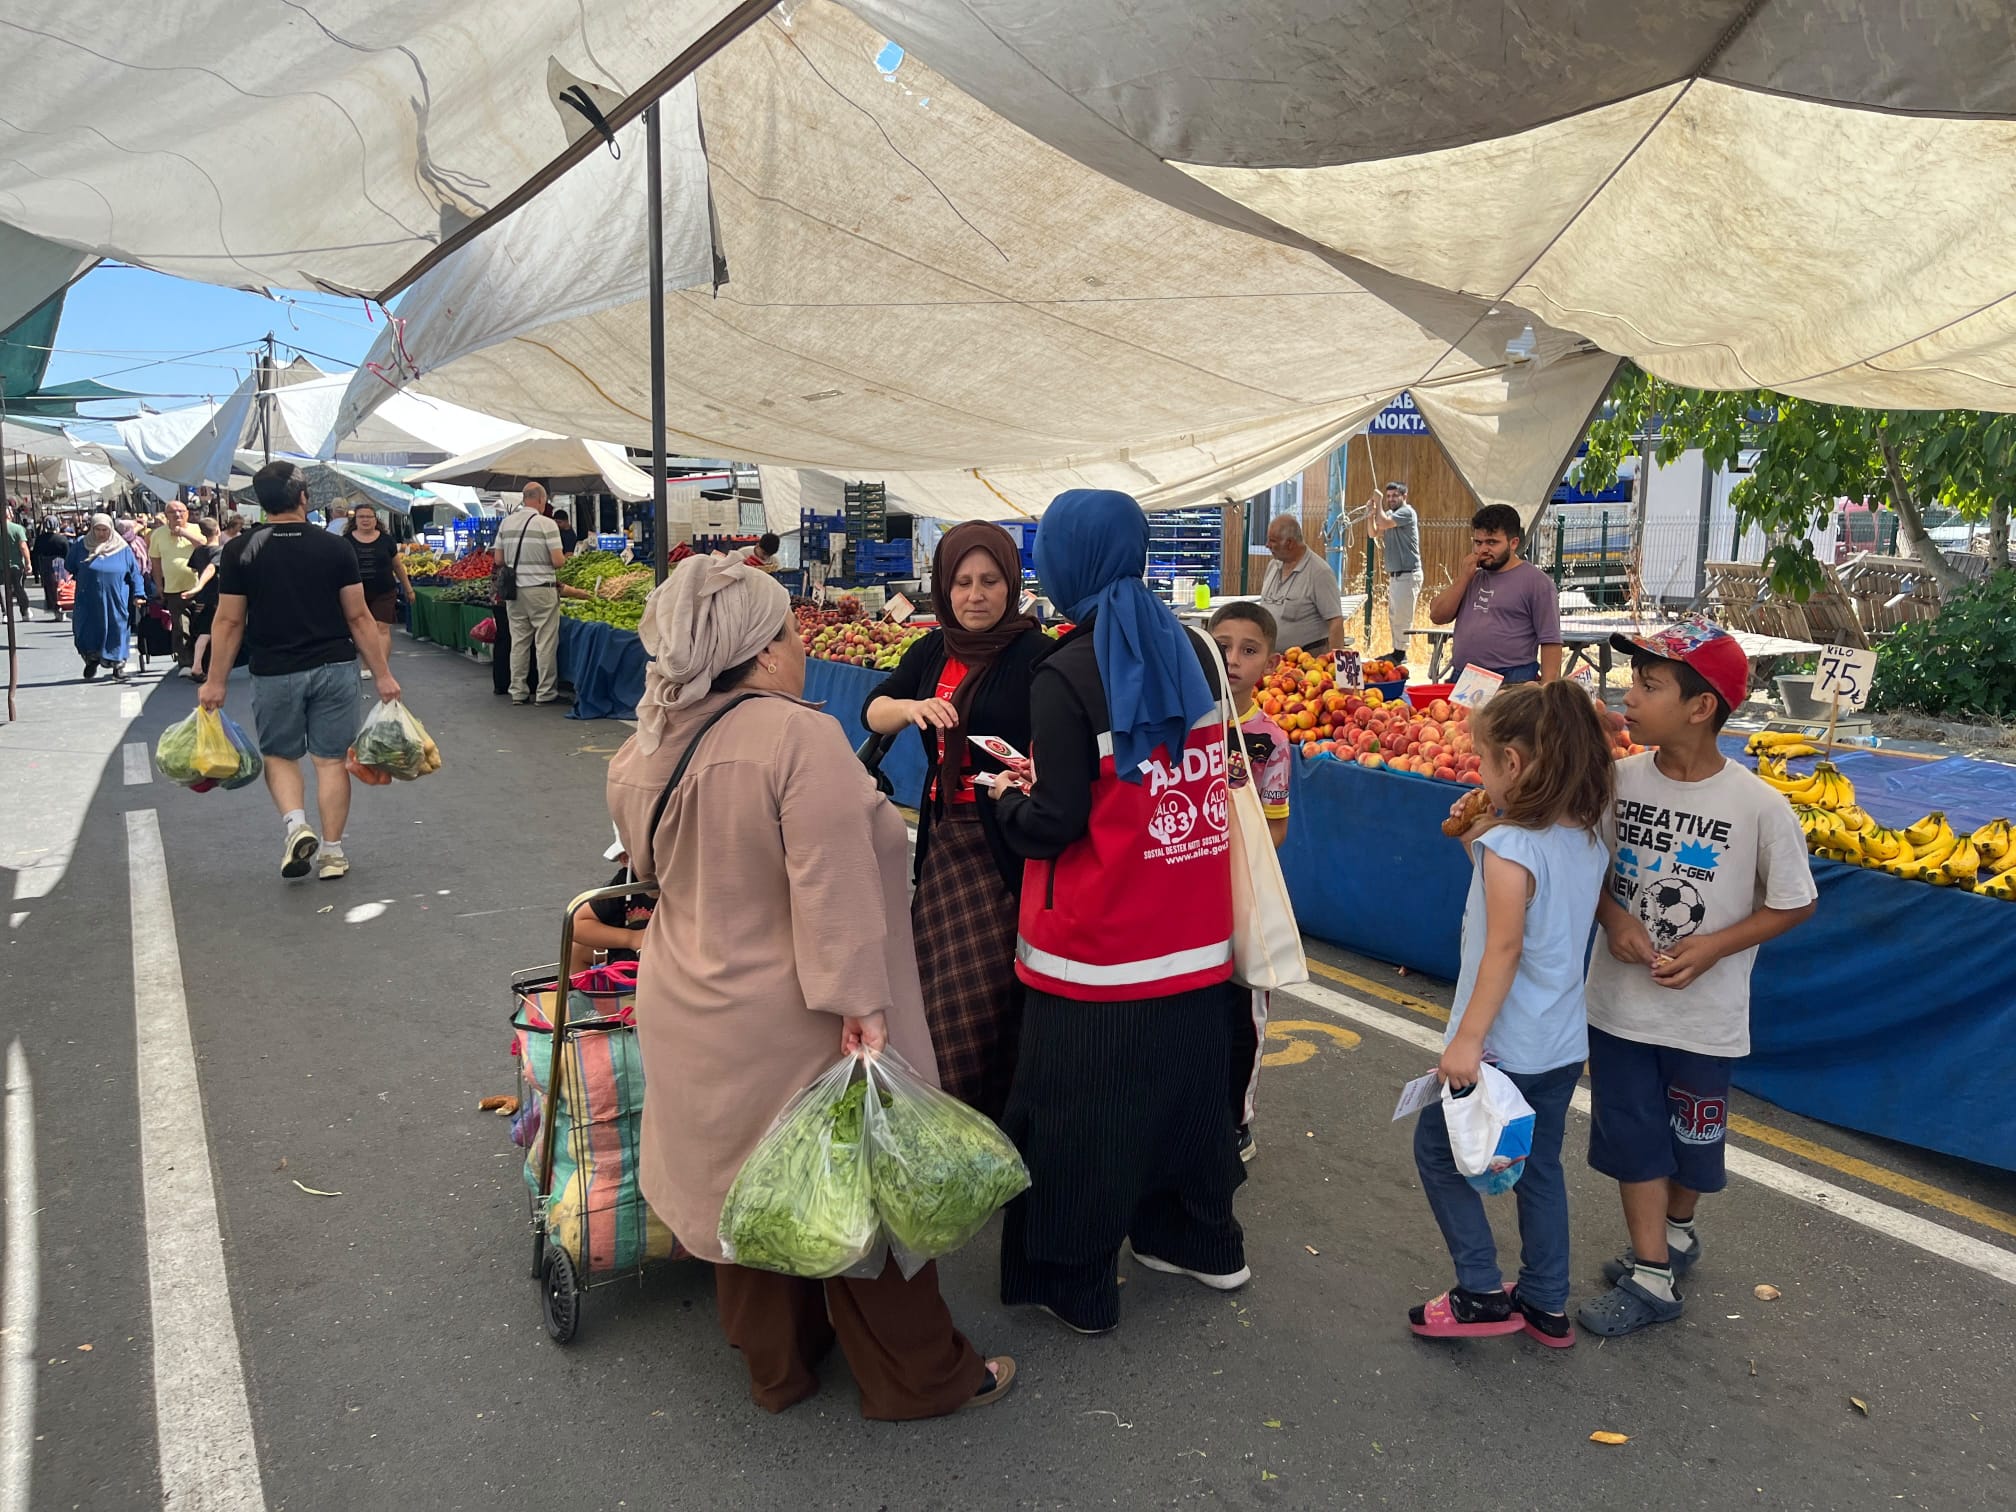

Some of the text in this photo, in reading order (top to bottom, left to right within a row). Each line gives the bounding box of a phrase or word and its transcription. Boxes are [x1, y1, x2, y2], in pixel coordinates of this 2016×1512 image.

[1149, 740, 1226, 797] ASDE
[1210, 789, 1225, 804] ALO
[1157, 800, 1178, 816] ALO
[1154, 811, 1190, 836] 183
[1615, 799, 1732, 843] CREATIVE
[1671, 862, 1715, 882] X-GEN
